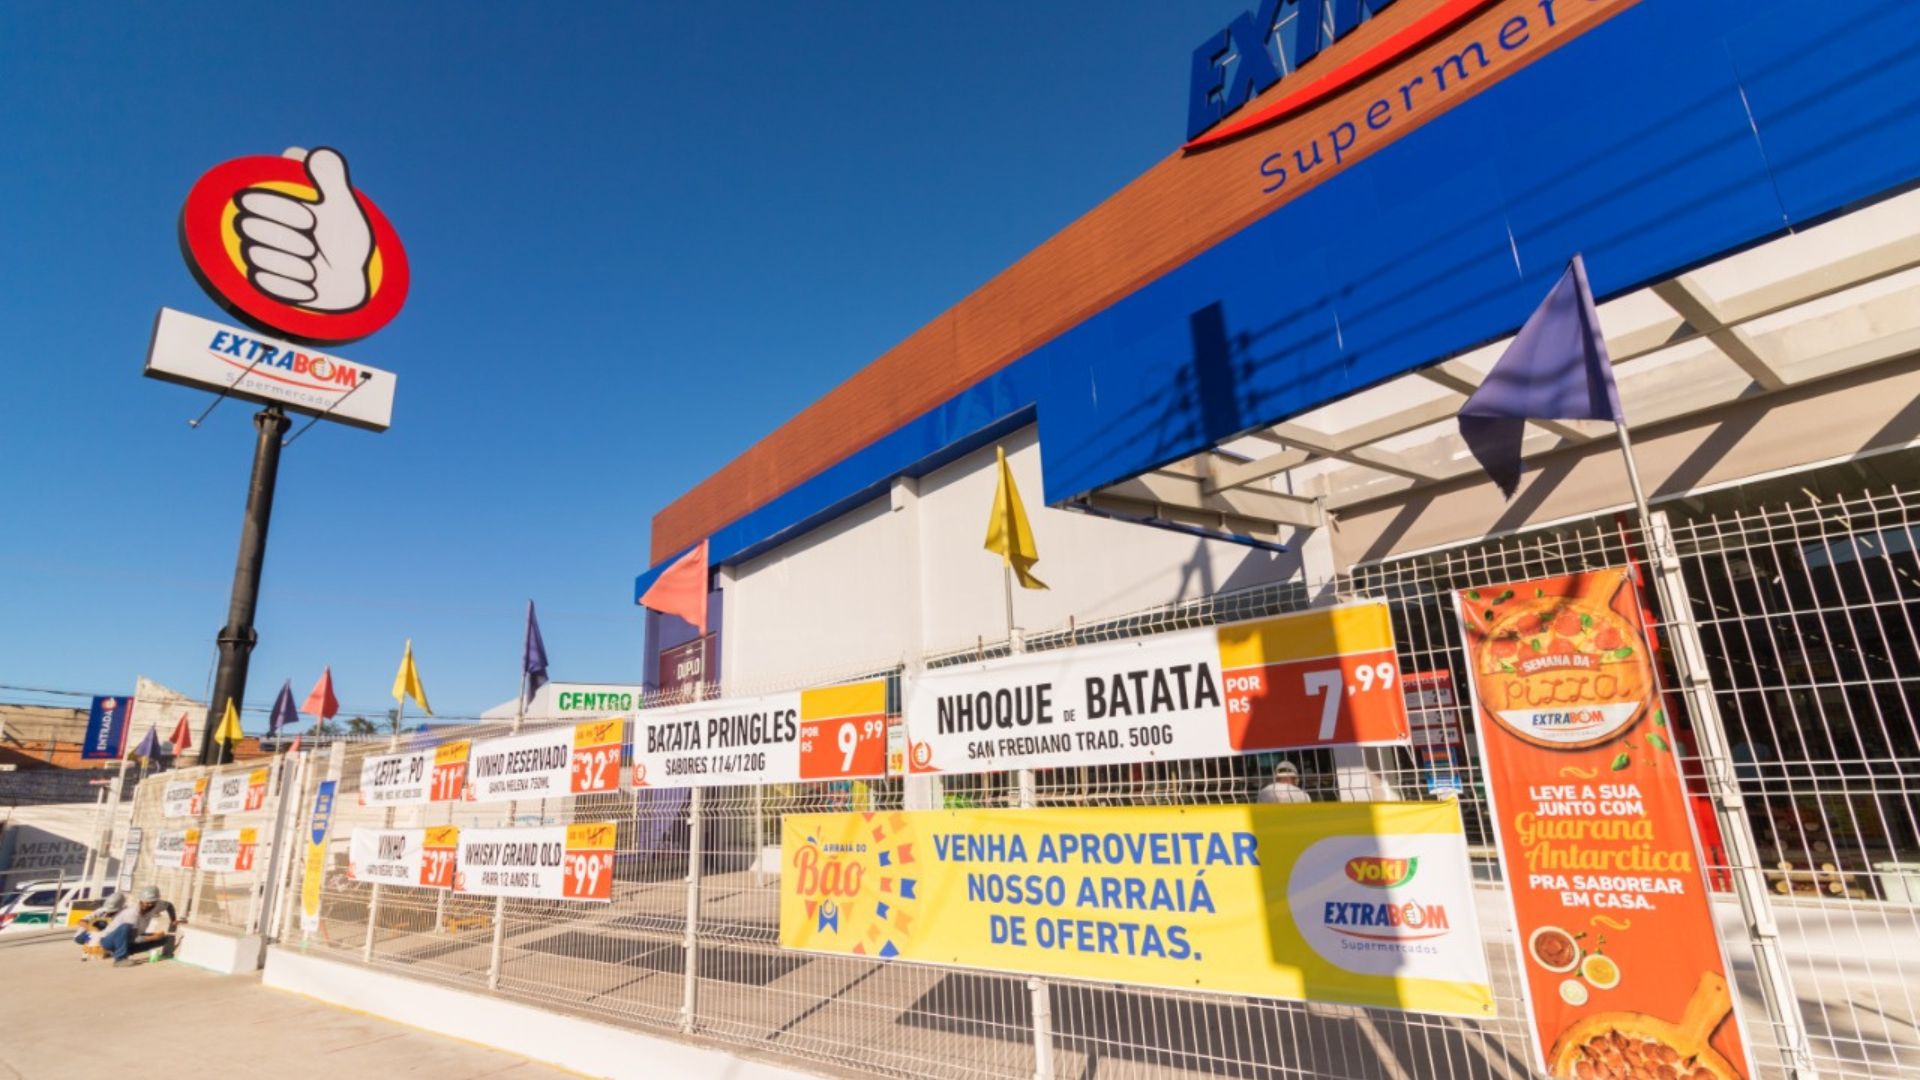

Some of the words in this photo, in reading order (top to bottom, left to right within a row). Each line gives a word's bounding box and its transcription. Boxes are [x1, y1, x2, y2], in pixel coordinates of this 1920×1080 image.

[1259, 0, 1596, 194] Supermer
[209, 330, 356, 388] EXTRABOM
[677, 657, 700, 680] DUPLO
[1522, 654, 1570, 672] SEMANA
[1573, 655, 1590, 667] DA
[937, 682, 1053, 735] NHOQUE
[1063, 709, 1076, 722] DE
[1085, 662, 1221, 720] BATATA
[1226, 675, 1261, 693] POR
[559, 692, 632, 711] CENTRO
[1228, 696, 1251, 713] R$
[1303, 662, 1395, 741] 7,99
[648, 720, 701, 753] BATATA
[707, 708, 797, 748] PRINGLES
[968, 740, 995, 760] SAN
[998, 733, 1072, 756] FREDIANO
[1076, 729, 1124, 751] TRAD.
[1129, 724, 1174, 748] 500G
[506, 744, 568, 774] RESERVADO
[665, 756, 707, 776] SABORES
[711, 752, 766, 773] 114/120G
[1529, 786, 1576, 800] LEVE
[1581, 787, 1596, 800] A
[1600, 785, 1642, 799] SUA
[1535, 801, 1596, 817] JUNTO
[1600, 801, 1643, 815] COM
[1515, 811, 1655, 847] Guaraná
[466, 844, 501, 866] WHISKY
[502, 843, 538, 866] GRAND
[541, 842, 562, 866] OLD
[933, 834, 1027, 863] VENHA
[1037, 832, 1260, 866] APROVEITAR
[1524, 842, 1692, 872] Antarctica
[793, 844, 866, 897] Bão
[1350, 860, 1403, 881] Yoki
[1529, 874, 1568, 890] PRA
[1573, 876, 1684, 894] SABOREAR
[968, 873, 1066, 906] NOSSO
[1075, 870, 1216, 913] ARRAIÁ
[1561, 892, 1590, 907] EM
[1593, 893, 1656, 910] CASA.
[1324, 902, 1450, 929] EXTRABOM
[990, 915, 1027, 946] DE
[1035, 917, 1202, 960] OFERTAS.
